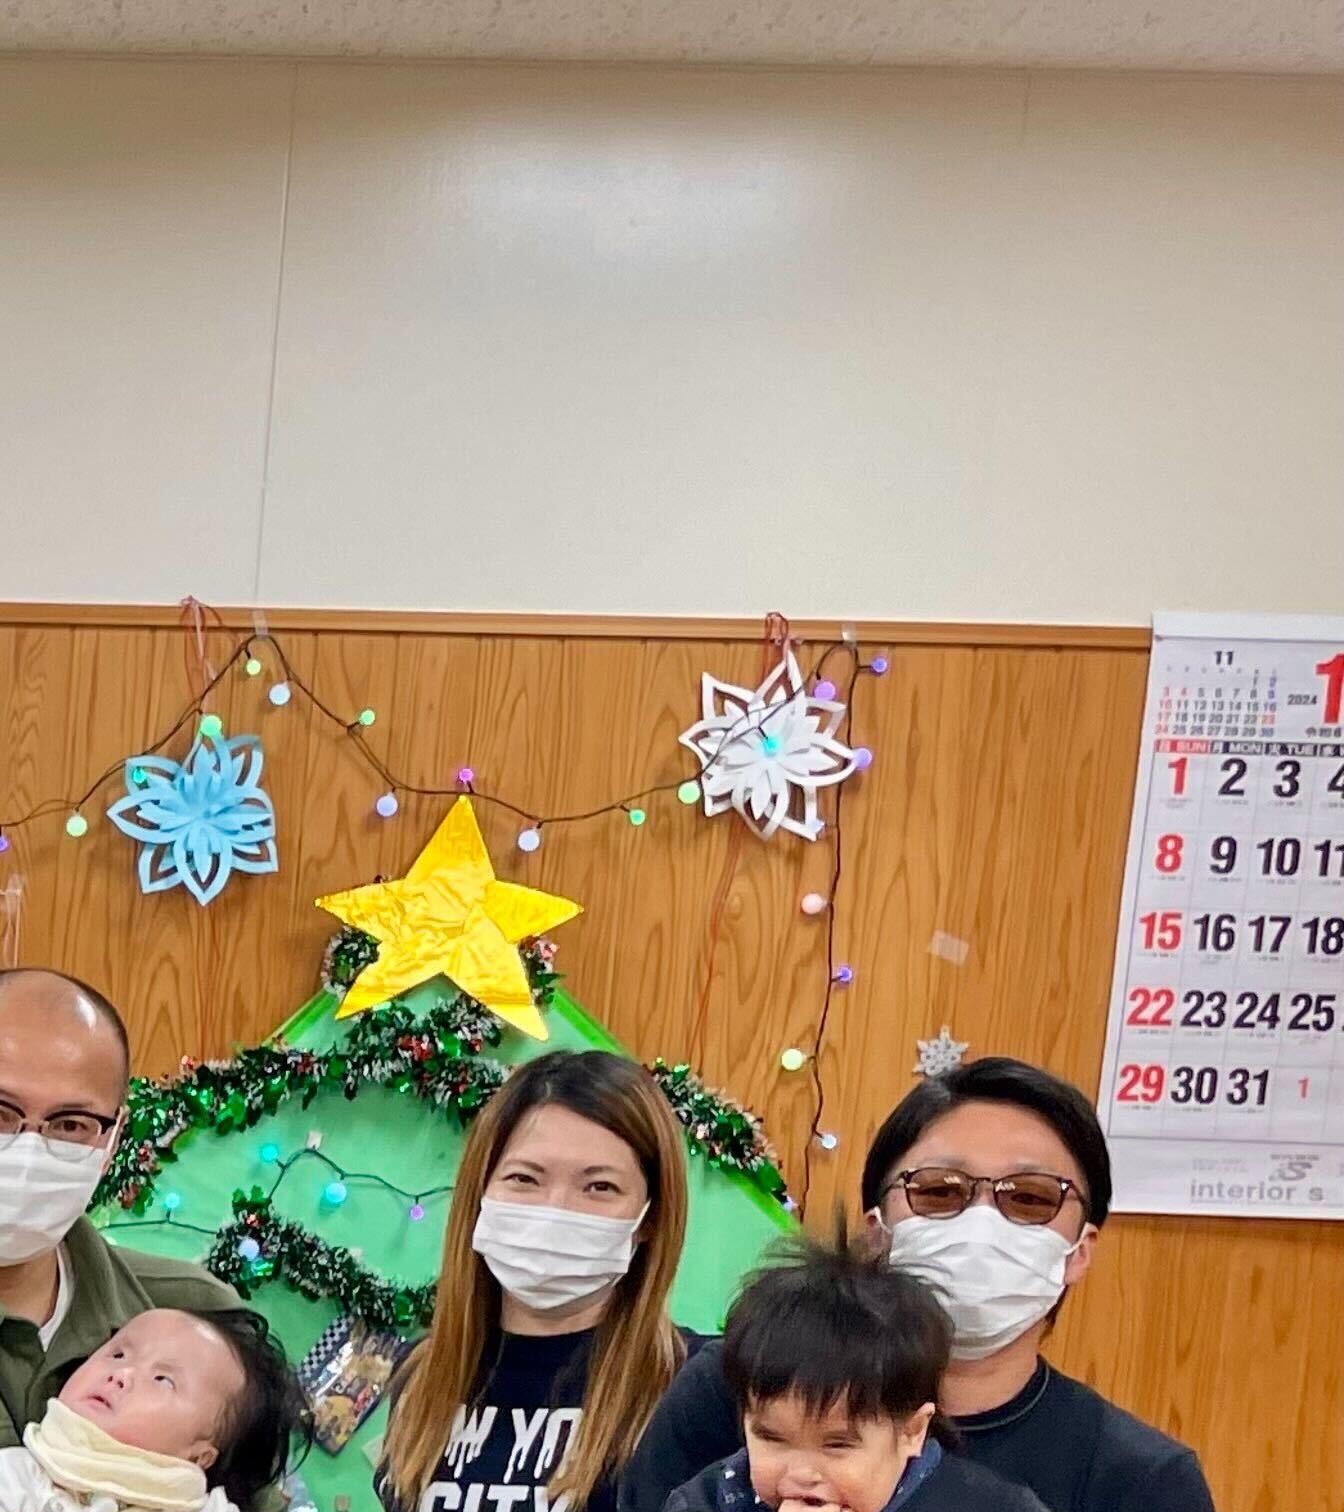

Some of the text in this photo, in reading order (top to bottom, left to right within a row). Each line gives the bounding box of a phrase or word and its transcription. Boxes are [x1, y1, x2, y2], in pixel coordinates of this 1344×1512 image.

[1214, 651, 1234, 665] 11
[1287, 694, 1317, 705] 2024
[1168, 757, 1188, 795] 1
[1218, 758, 1248, 796] 2
[1273, 760, 1300, 798] 3
[1155, 834, 1184, 874] 8
[1210, 836, 1238, 874] 9
[1256, 838, 1301, 876] 10
[1139, 912, 1344, 956] 15 16 17 18
[1126, 987, 1336, 1032] 22 23 24 25
[1116, 1064, 1164, 1103] 29
[1170, 1066, 1218, 1106] 30
[1226, 1068, 1270, 1107] 31
[1190, 1179, 1296, 1201] interior
